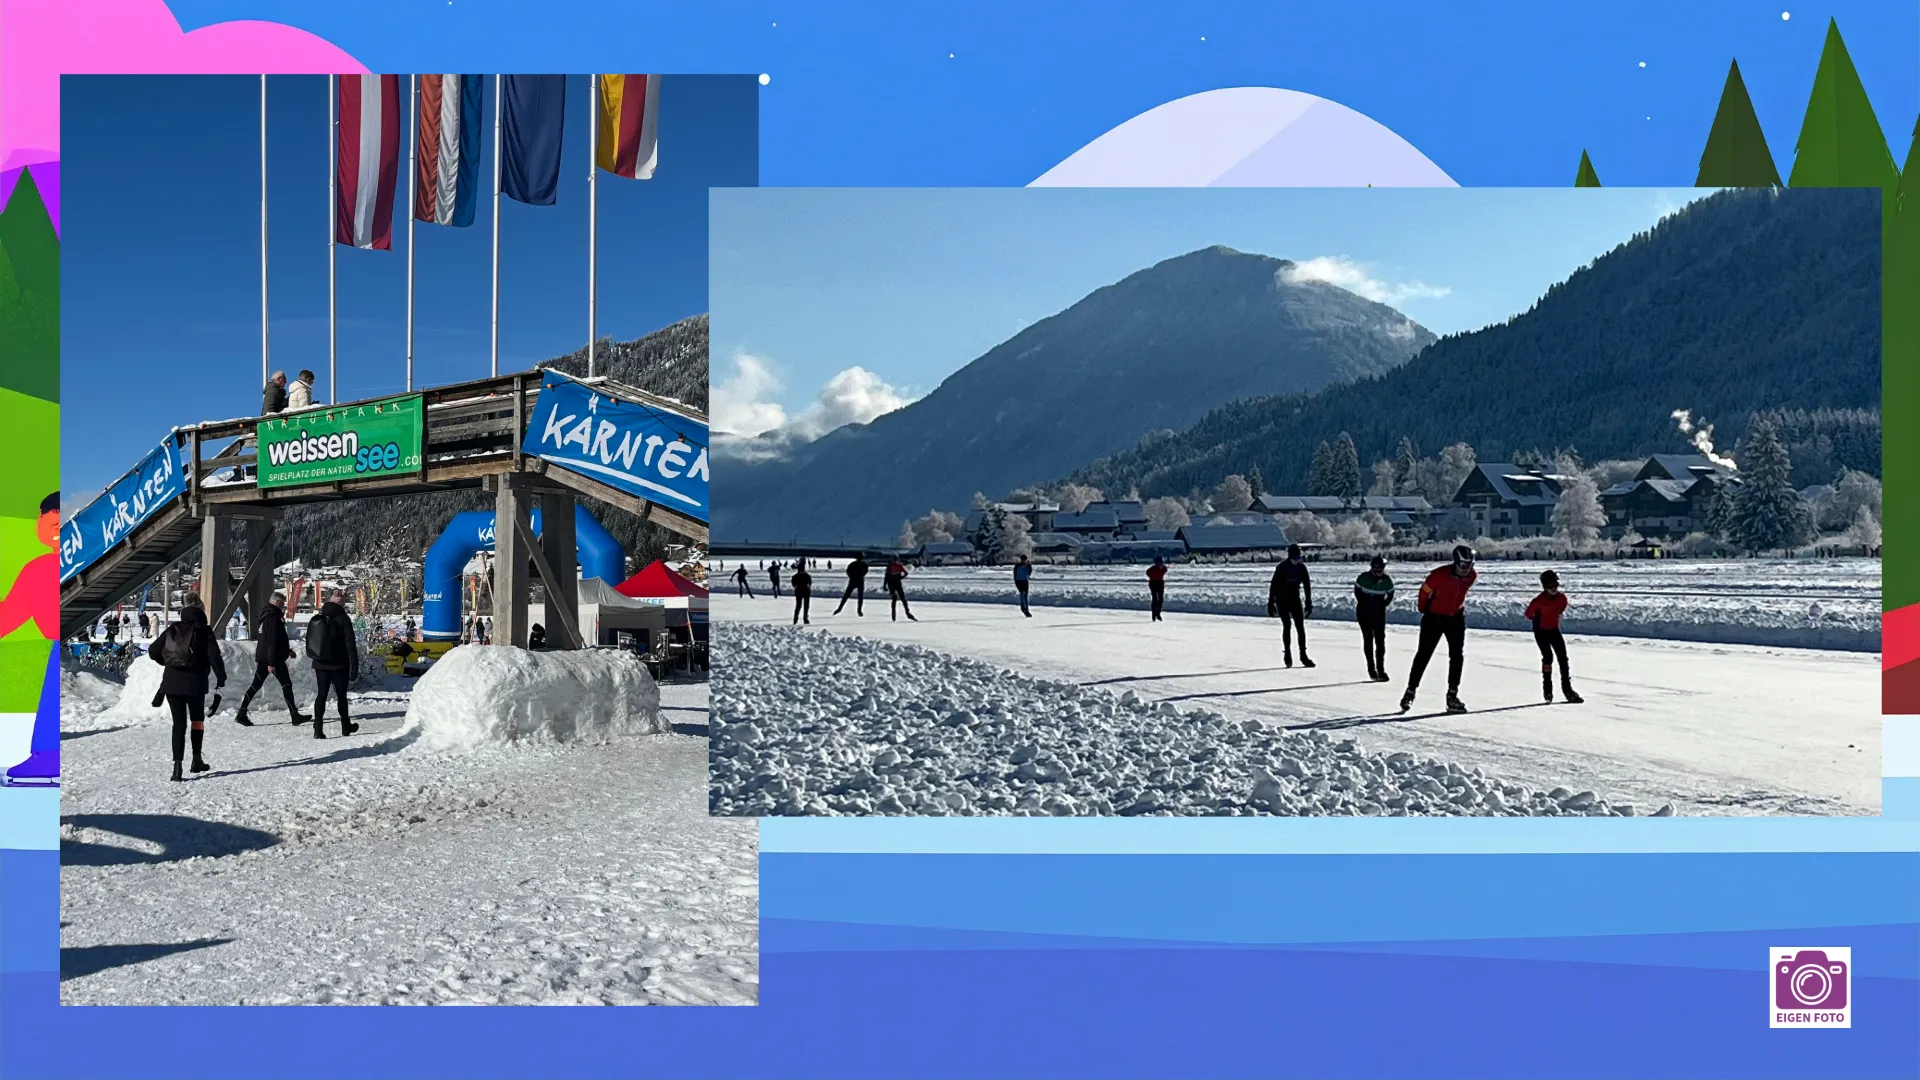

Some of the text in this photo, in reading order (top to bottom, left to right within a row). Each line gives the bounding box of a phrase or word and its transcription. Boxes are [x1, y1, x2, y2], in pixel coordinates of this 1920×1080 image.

[102, 445, 173, 548] KÄRNTEN
[268, 464, 353, 482] SPIELPLATZ DER NATUR
